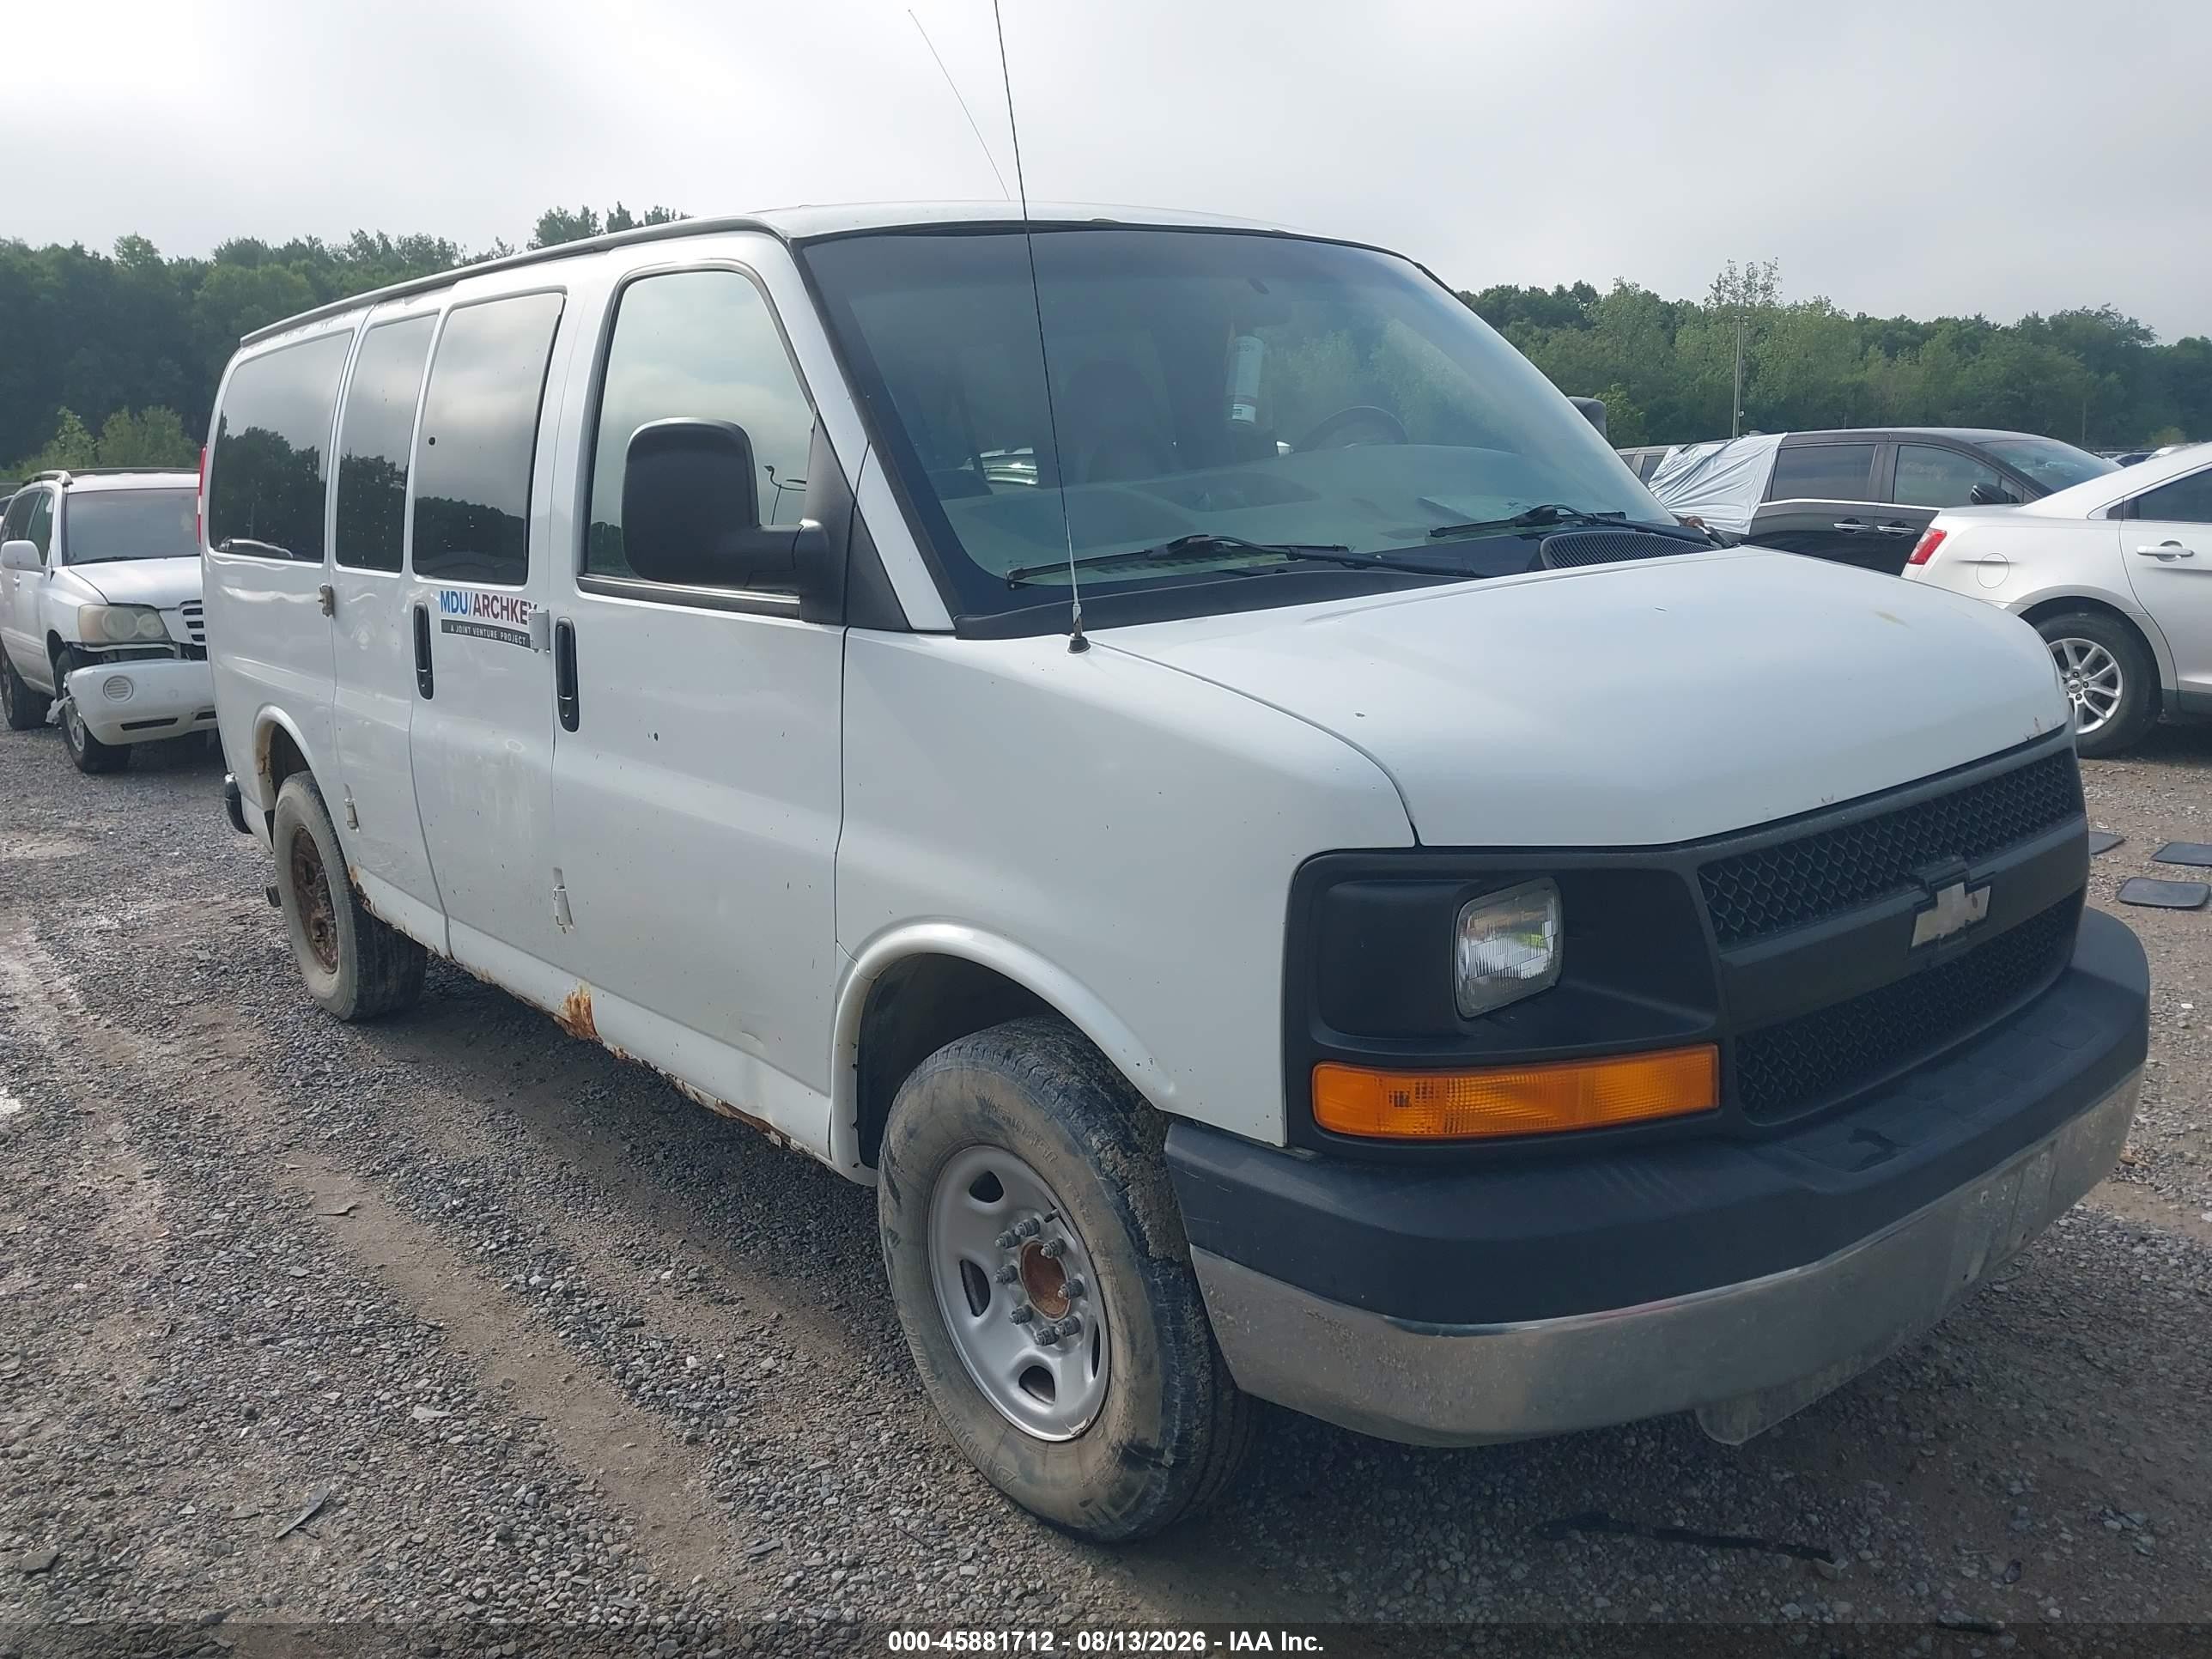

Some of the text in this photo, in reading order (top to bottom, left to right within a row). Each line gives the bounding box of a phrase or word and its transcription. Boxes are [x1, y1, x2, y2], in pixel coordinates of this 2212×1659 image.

[456, 625, 471, 634] JOINT
[472, 627, 498, 639] VENTURE
[500, 631, 526, 646] PROJECT
